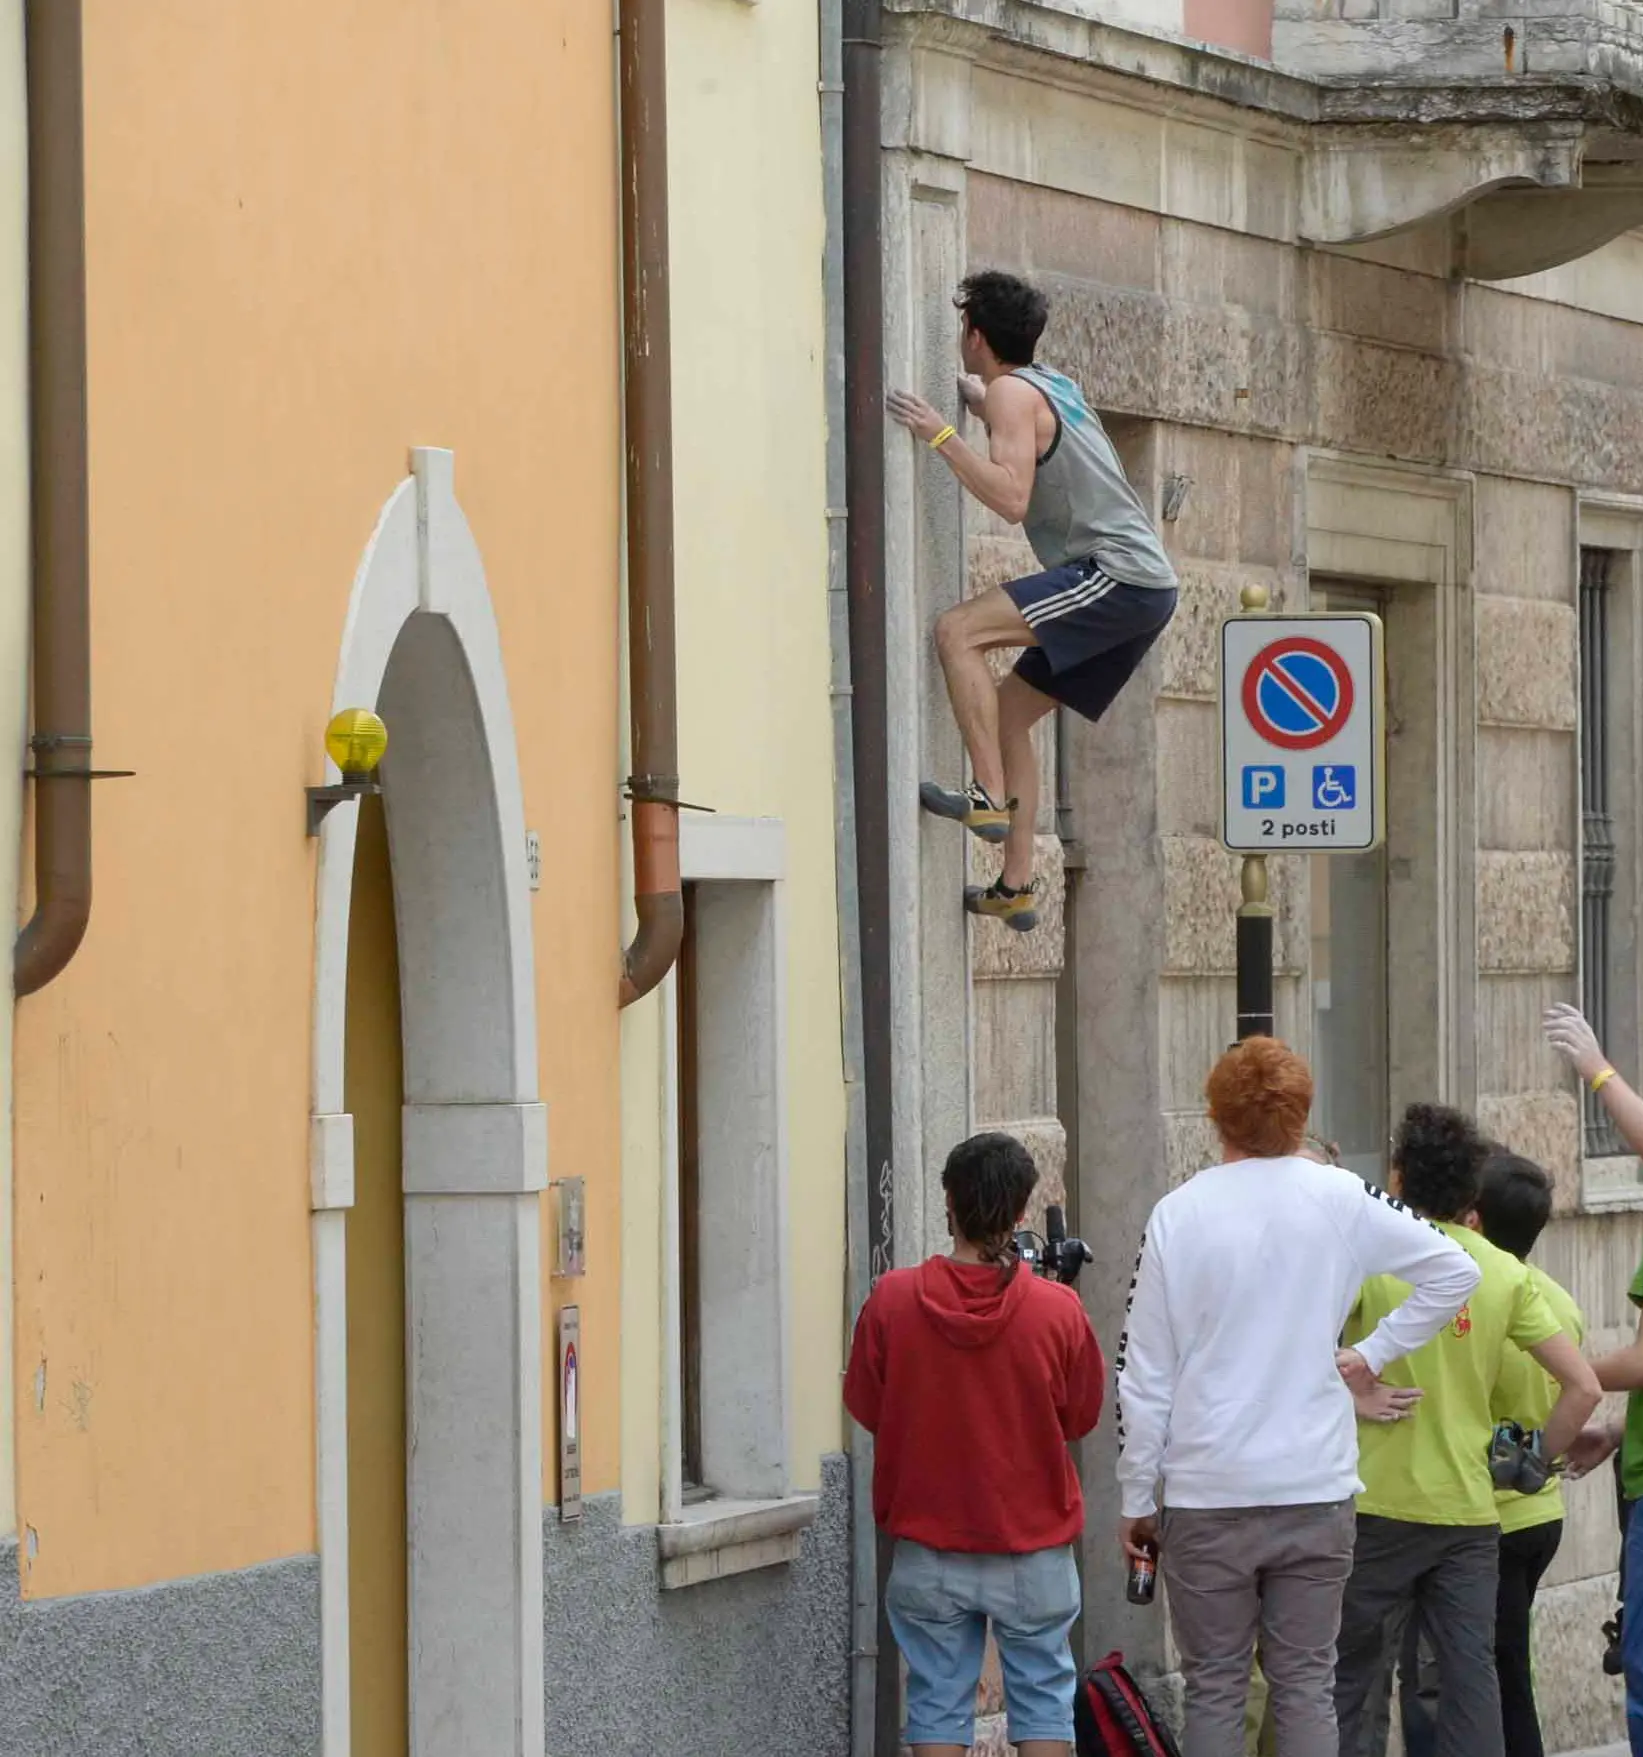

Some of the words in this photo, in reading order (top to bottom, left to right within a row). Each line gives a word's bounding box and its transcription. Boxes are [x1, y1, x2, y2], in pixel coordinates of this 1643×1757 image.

[1251, 771, 1277, 804] P
[1261, 820, 1274, 836] 2
[1282, 819, 1335, 838] posti
